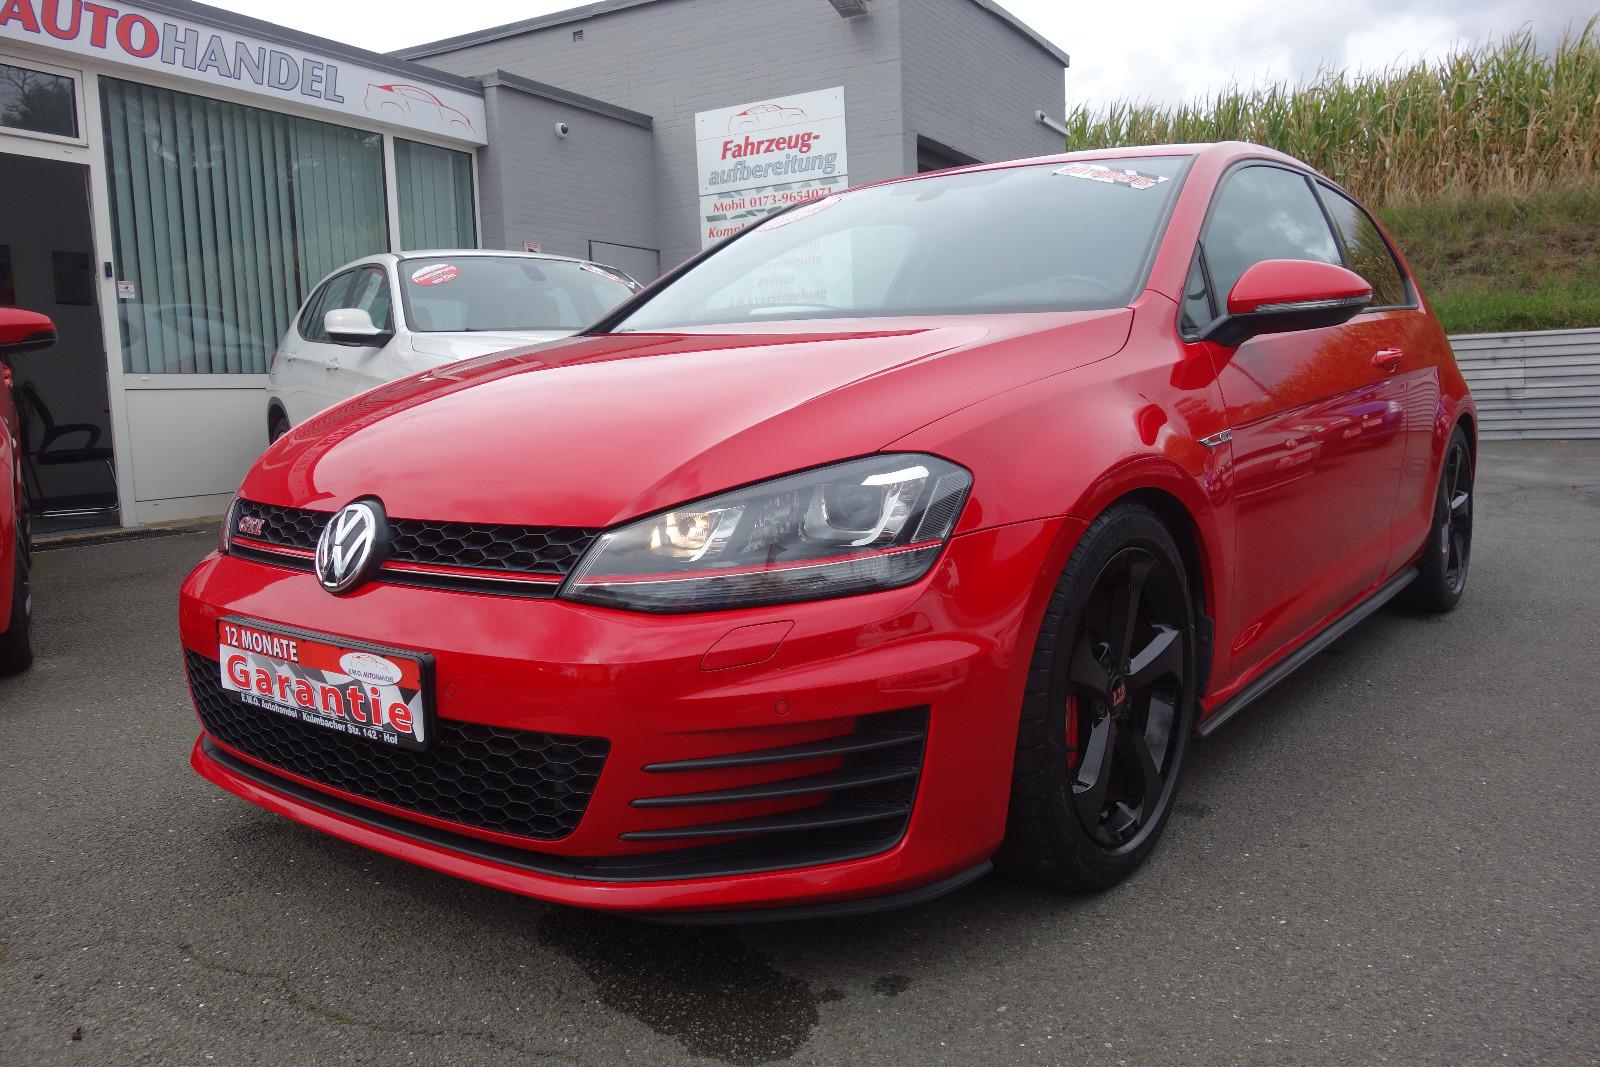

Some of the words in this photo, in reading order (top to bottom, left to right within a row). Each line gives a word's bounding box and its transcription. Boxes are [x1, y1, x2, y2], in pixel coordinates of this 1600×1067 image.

[721, 131, 821, 160] Fahrzeug-
[708, 152, 837, 186] aufbereitung
[713, 200, 745, 213] Mobil
[225, 625, 239, 645] 12
[241, 630, 299, 662] MONATE
[227, 654, 414, 734] Garantie
[261, 700, 298, 718] Autohandel
[302, 711, 346, 732] Kulmbacher
[347, 723, 361, 736] Str.
[363, 727, 378, 740] 142
